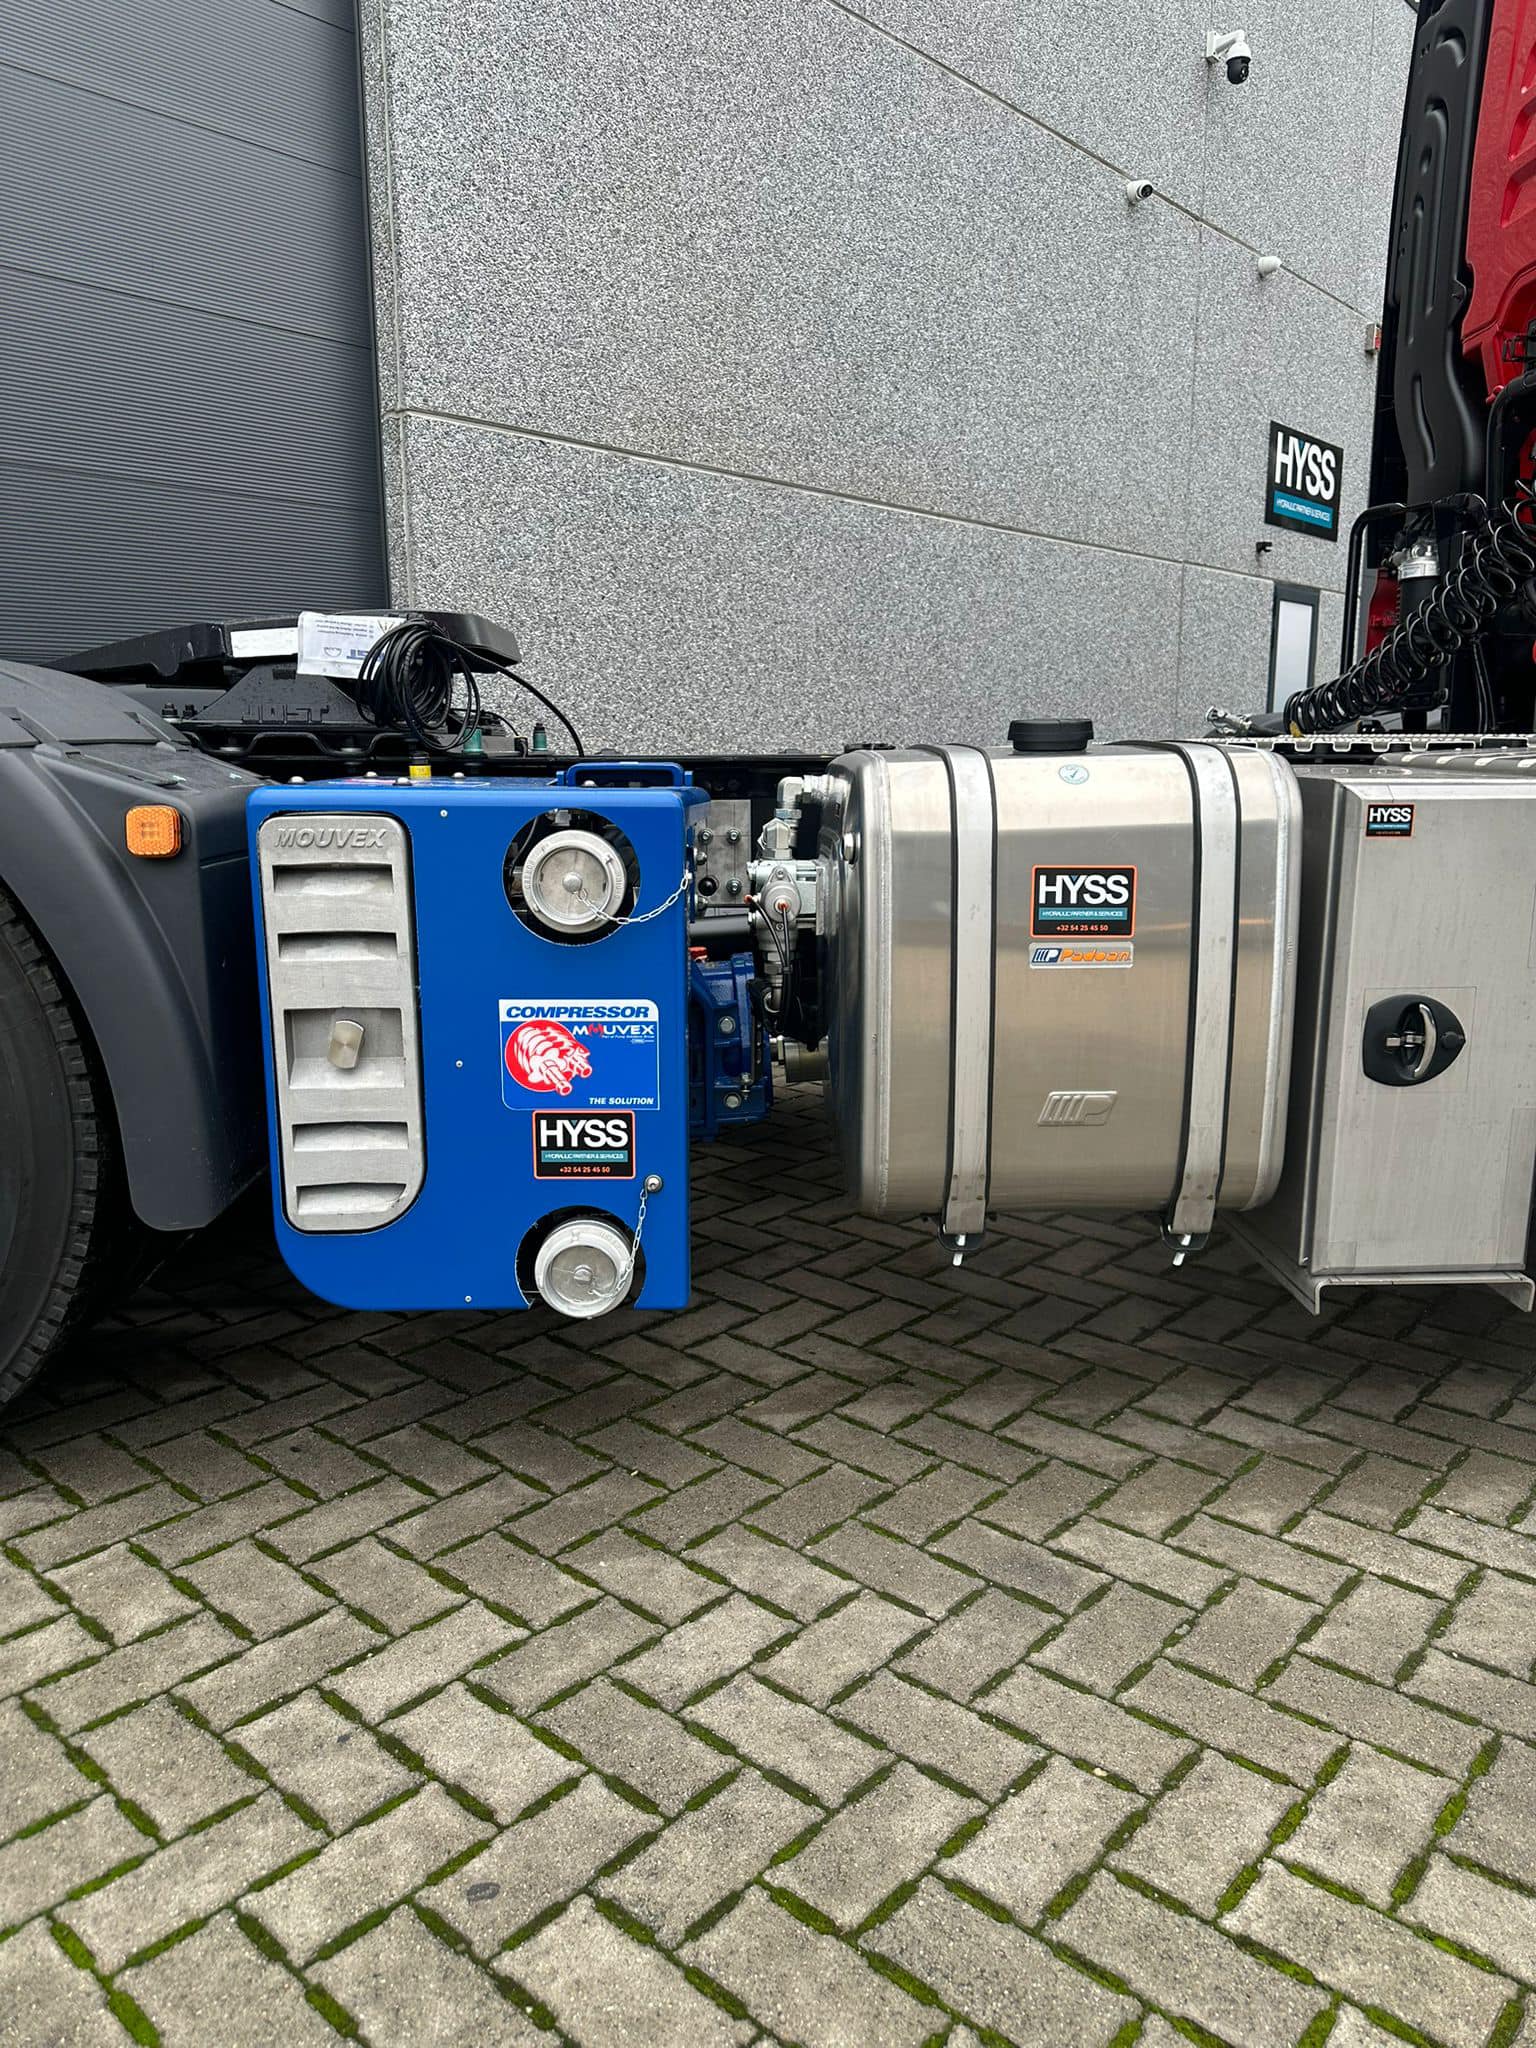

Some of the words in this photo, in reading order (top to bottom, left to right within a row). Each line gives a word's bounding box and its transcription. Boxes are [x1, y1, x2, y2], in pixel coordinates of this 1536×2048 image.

[1275, 431, 1336, 501] HYSS
[242, 703, 329, 724] JOST
[1369, 807, 1411, 822] HYSS
[274, 828, 387, 848] MOUVEX
[1038, 874, 1129, 904] HYSS
[1060, 949, 1131, 962] Padoan
[505, 1006, 649, 1019] COMPRESSOR
[589, 1097, 606, 1105] THE
[608, 1097, 654, 1105] SOLUTION
[540, 1119, 628, 1147] HYSS
